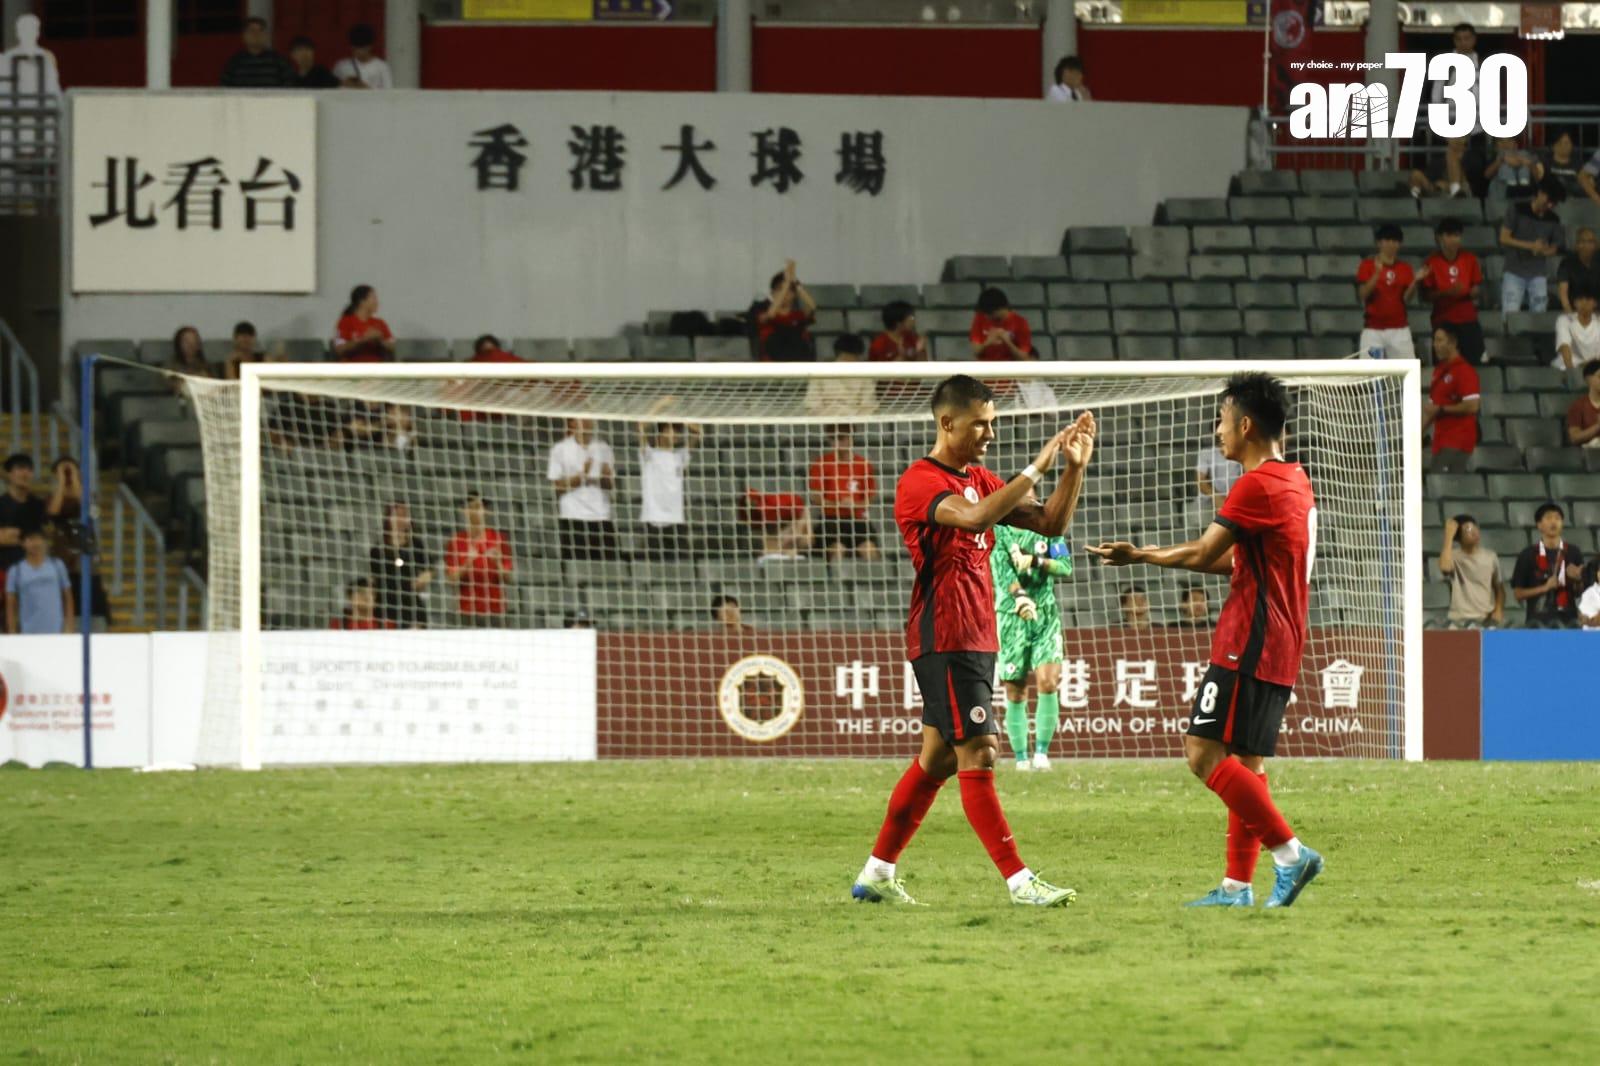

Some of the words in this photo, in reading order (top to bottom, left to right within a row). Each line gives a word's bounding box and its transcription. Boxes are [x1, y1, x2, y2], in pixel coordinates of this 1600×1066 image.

[468, 123, 887, 197] 香港大球場
[89, 156, 302, 231] 北看台
[1200, 681, 1219, 713] 8
[836, 718, 874, 735] THE
[1129, 716, 1156, 734] OF
[1301, 717, 1364, 733] CHINA
